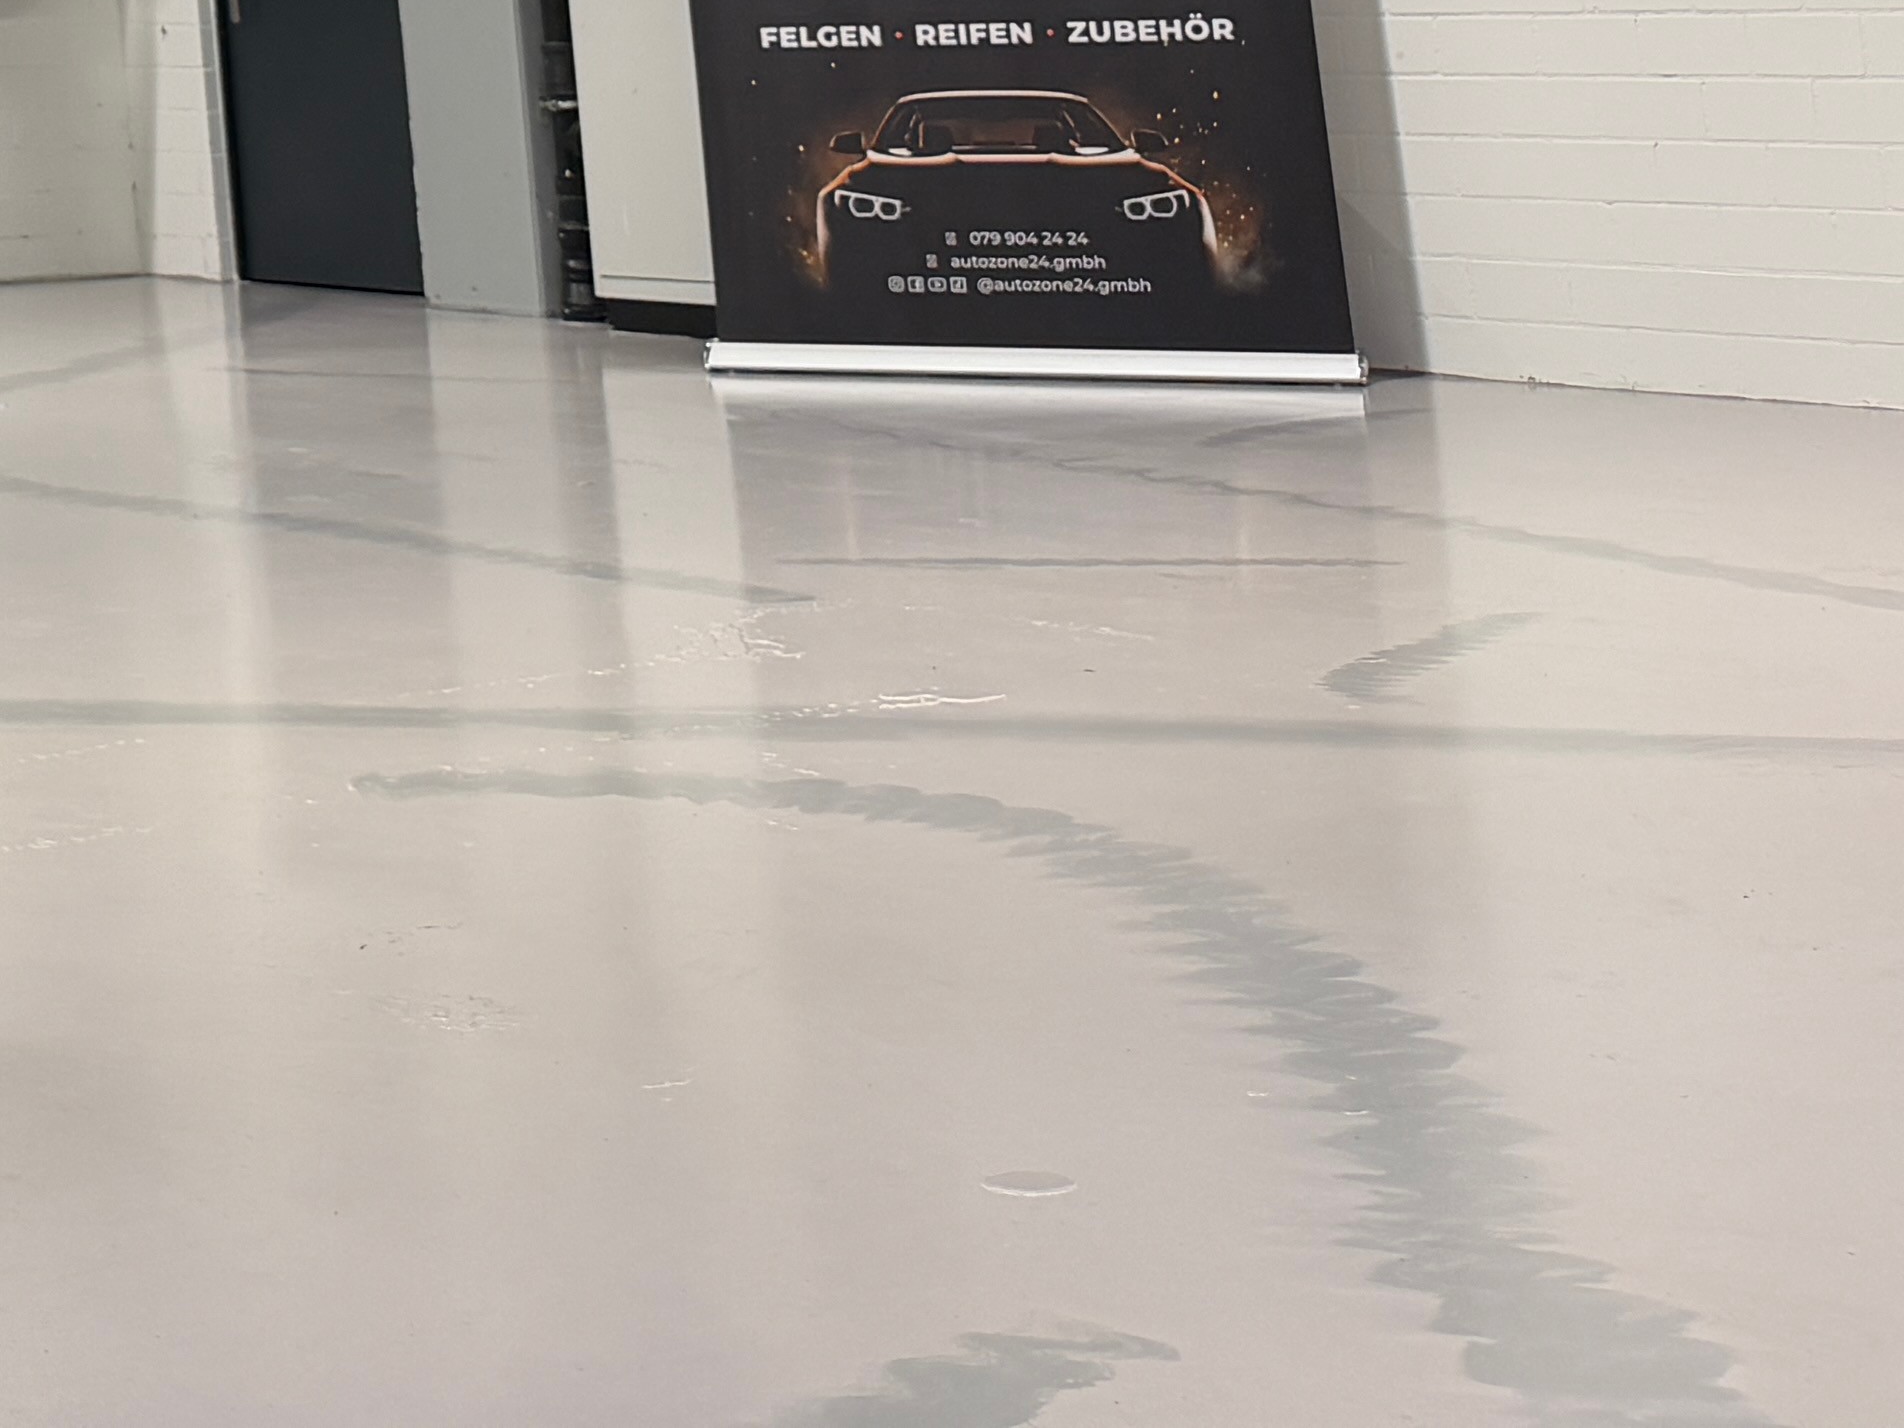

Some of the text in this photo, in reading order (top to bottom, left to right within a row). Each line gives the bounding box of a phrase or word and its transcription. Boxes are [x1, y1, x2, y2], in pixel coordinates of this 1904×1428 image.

[759, 12, 1235, 49] FELGEN REIFEN ZUBEHÖR
[969, 231, 1089, 246] 079 904 24 24
